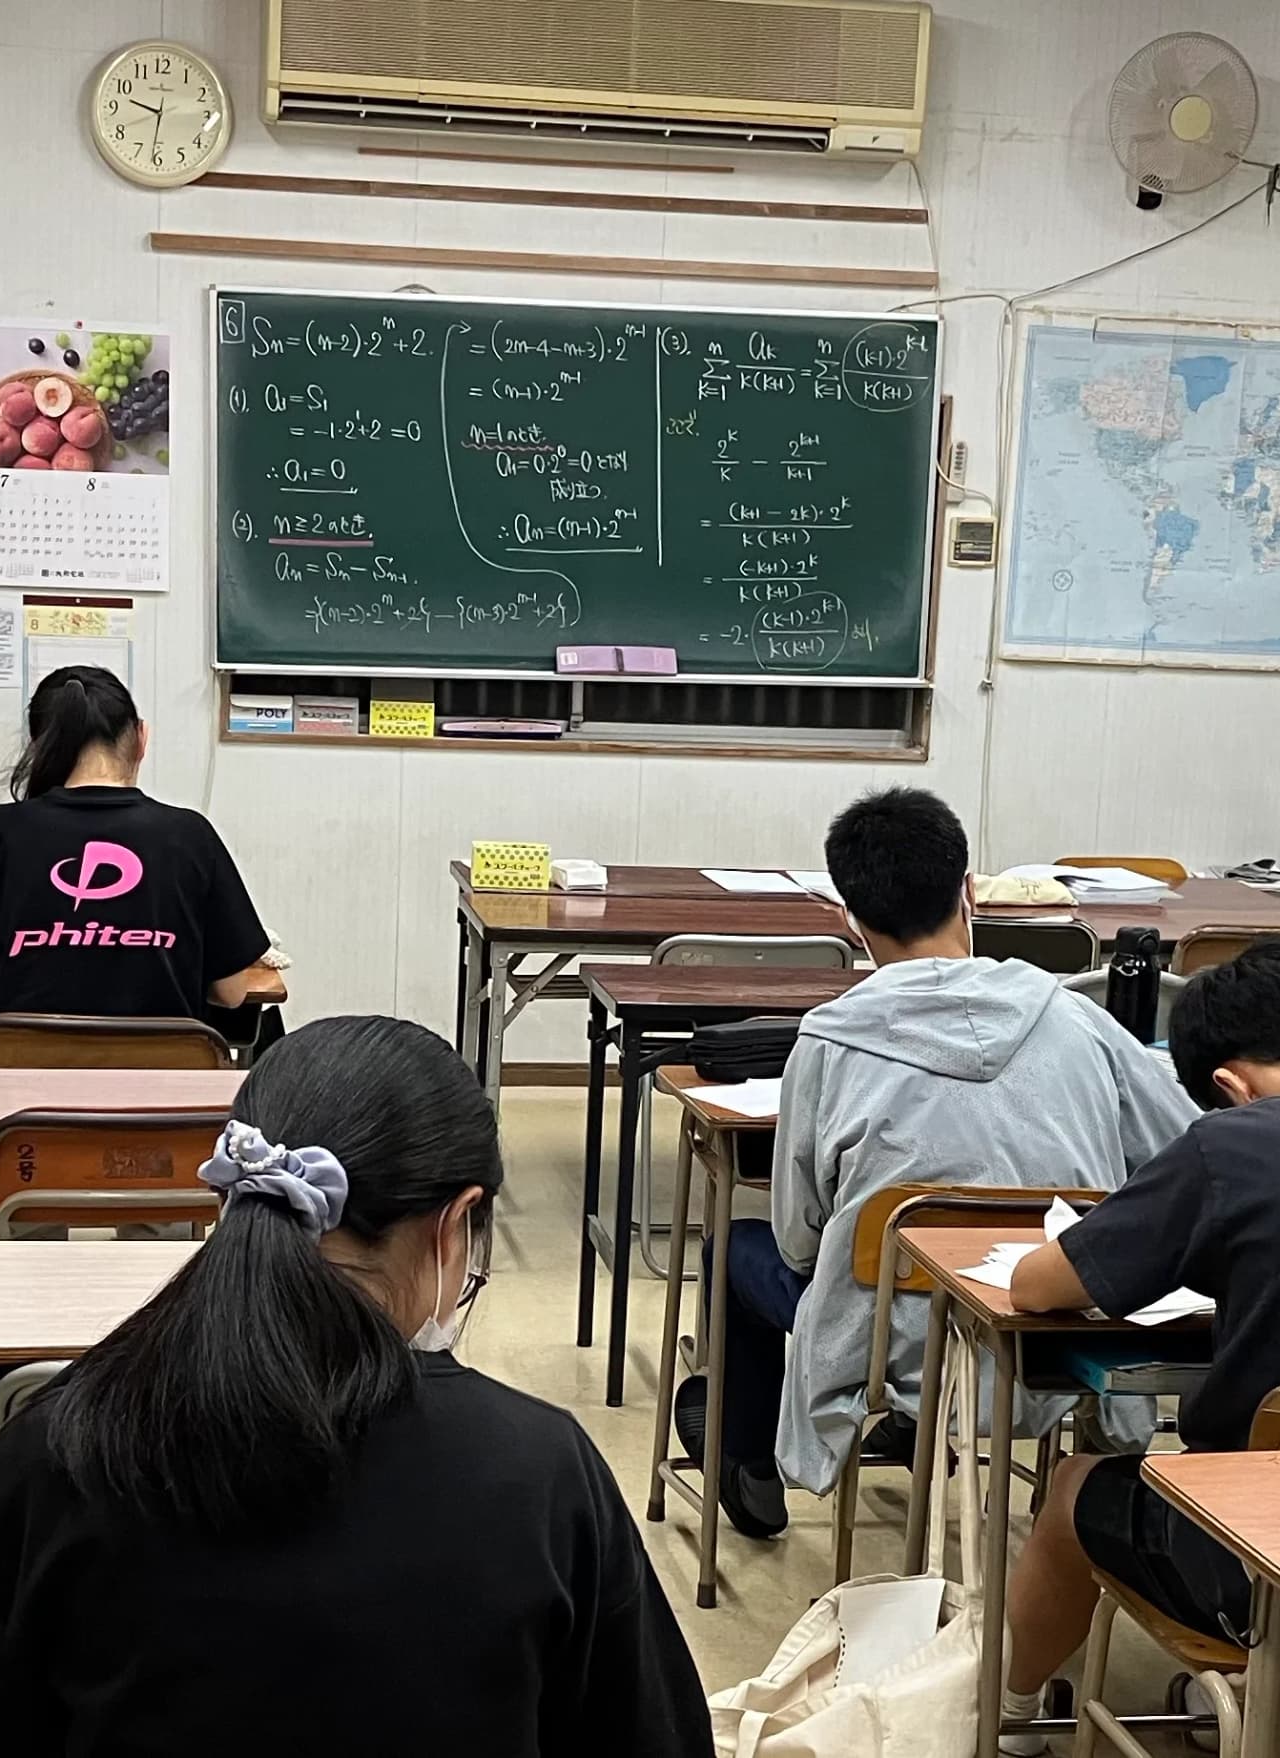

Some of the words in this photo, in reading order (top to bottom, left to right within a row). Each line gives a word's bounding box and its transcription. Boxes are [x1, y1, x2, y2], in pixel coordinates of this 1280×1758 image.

[134, 63, 148, 80] 11
[154, 58, 171, 74] 12
[183, 68, 189, 84] 1
[117, 78, 132, 95] 10
[197, 87, 207, 102] 2
[108, 100, 119, 116] 9
[115, 124, 125, 140] 8
[192, 133, 202, 149] 4
[133, 142, 144, 158] 7
[175, 147, 186, 163] 5
[152, 150, 163, 167] 6
[0, 474, 10, 488] 7
[86, 478, 97, 491] 8
[255, 707, 288, 719] POLY
[9, 921, 177, 958] phiten
